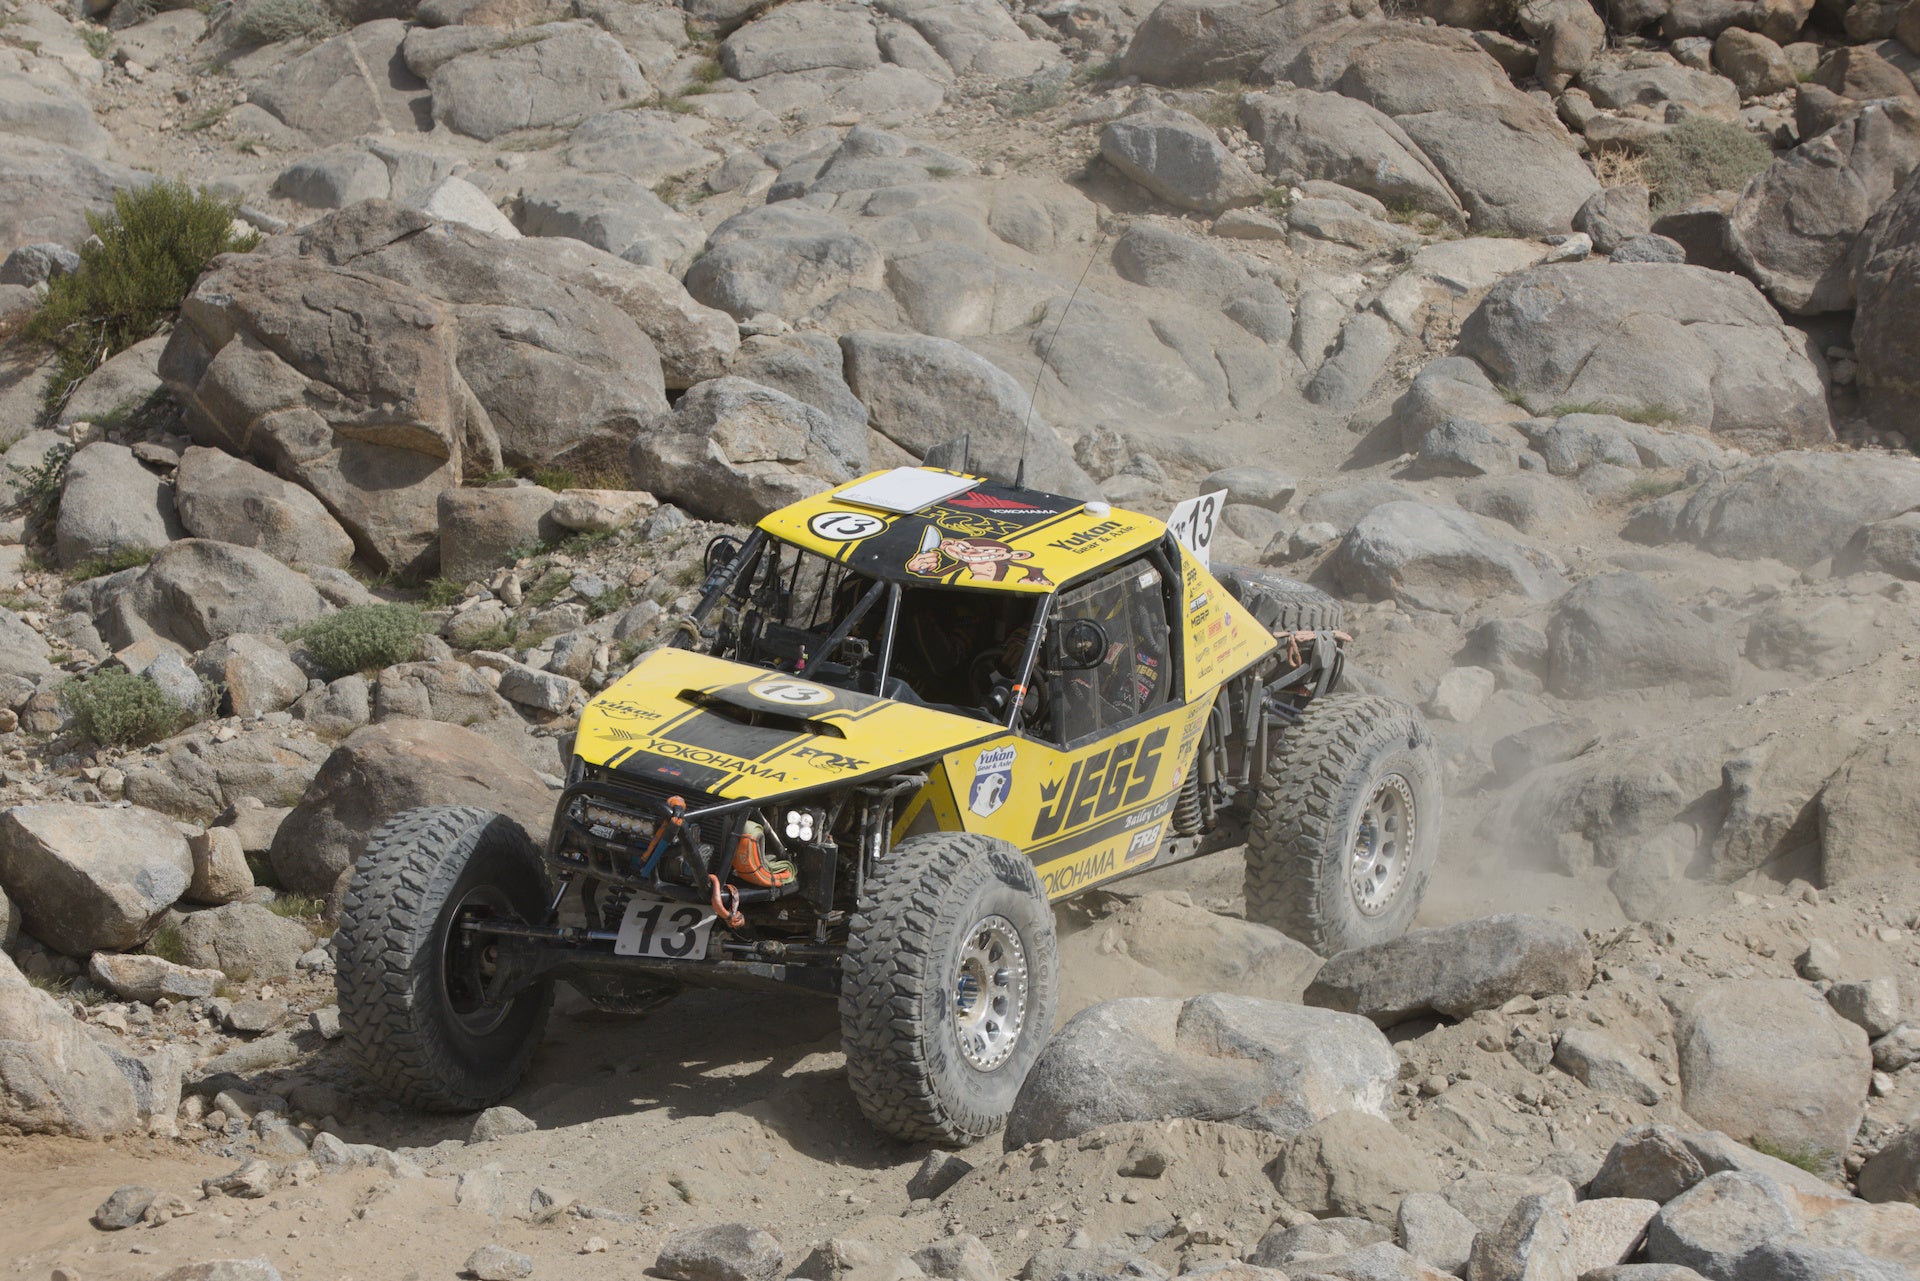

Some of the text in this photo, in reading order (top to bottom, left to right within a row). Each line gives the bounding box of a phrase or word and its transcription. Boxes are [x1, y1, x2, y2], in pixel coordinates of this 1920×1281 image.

[820, 514, 870, 535] 13
[989, 508, 1059, 516] YOKOHAMA
[1189, 496, 1215, 551] 13
[1047, 520, 1124, 552] Yukon
[1072, 525, 1135, 555] Gear & Axle
[1190, 610, 1210, 628] MBRP
[762, 684, 820, 701] 13
[598, 699, 663, 719] Yukon
[646, 739, 788, 783] YOKOHAMA
[790, 746, 870, 774] FOX
[979, 751, 1014, 765] Yukon
[998, 760, 1012, 768] Axle
[1031, 726, 1170, 841] JEGS
[1124, 810, 1151, 829] Bailey
[1129, 824, 1160, 852] FR8
[1040, 847, 1115, 895] OKOHAMA
[636, 904, 703, 957] 13
